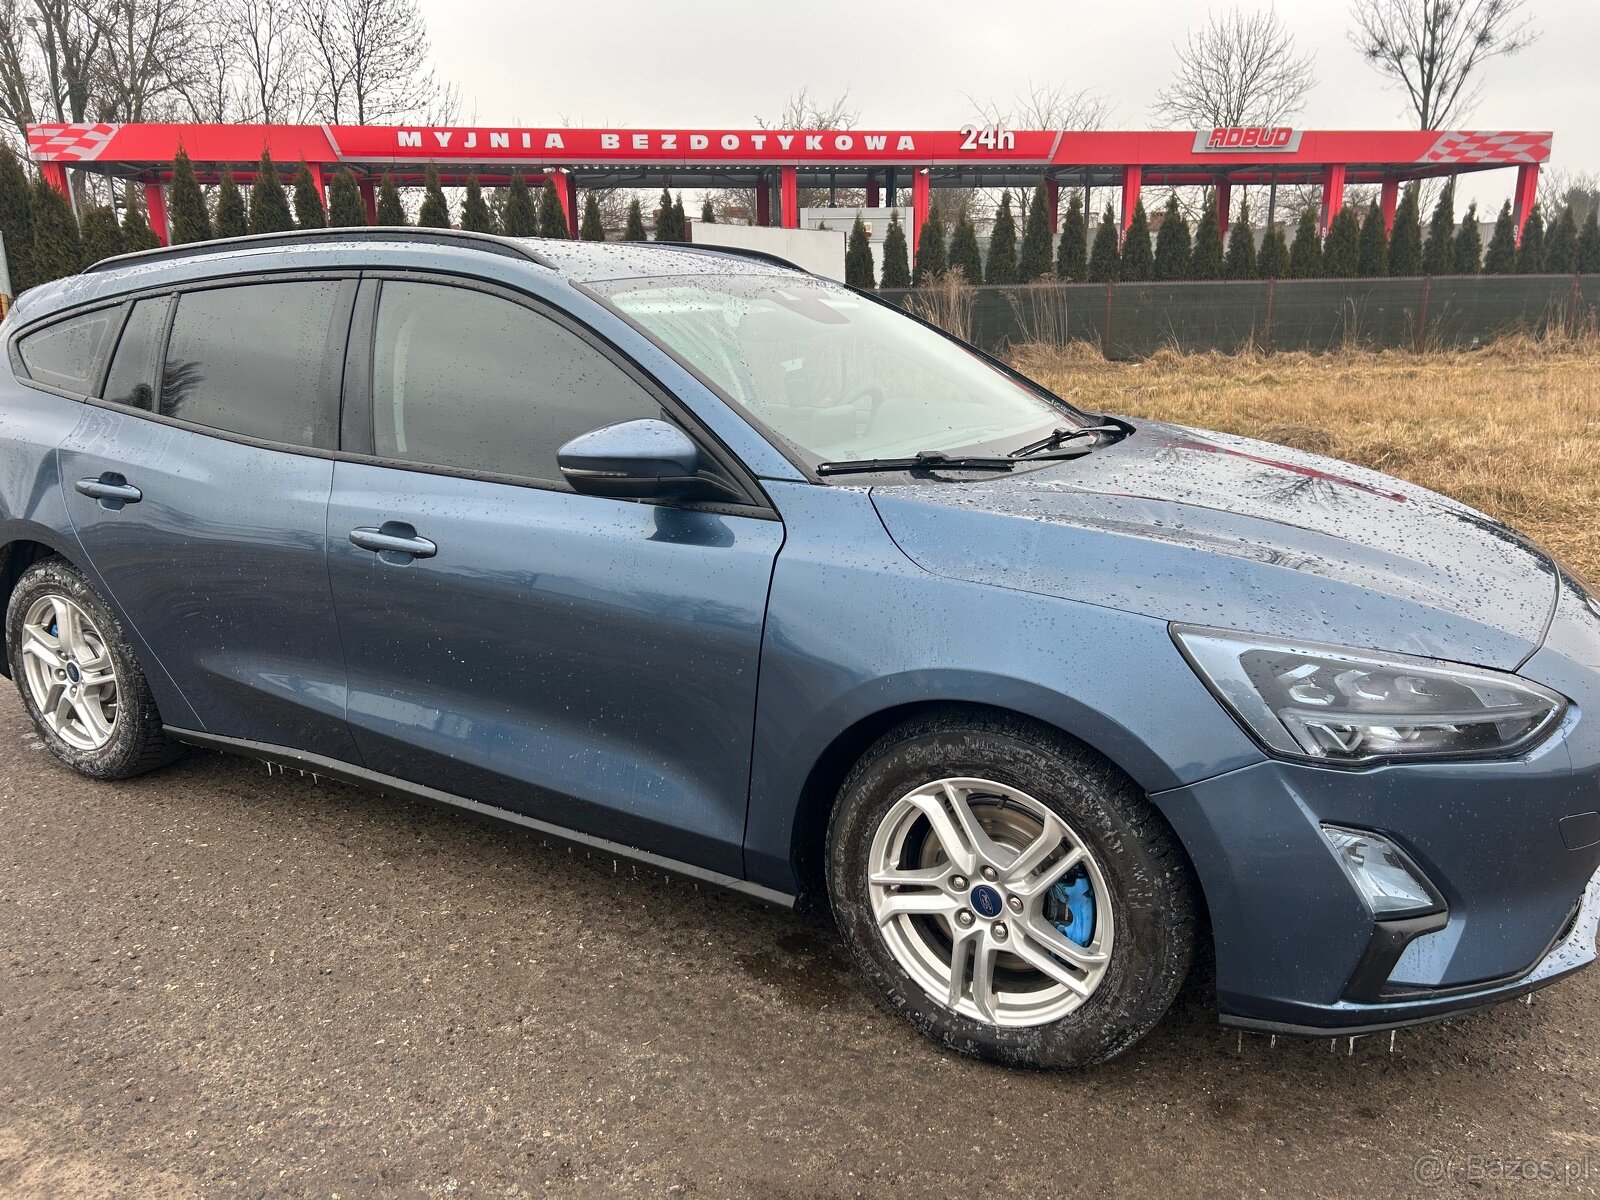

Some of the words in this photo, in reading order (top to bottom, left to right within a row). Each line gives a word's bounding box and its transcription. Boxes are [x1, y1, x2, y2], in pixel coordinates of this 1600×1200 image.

[397, 131, 565, 149] MYJNIA
[601, 133, 916, 151] BEZDOTYKOWA
[959, 122, 1015, 150] 24h
[1207, 127, 1293, 148] ADBUD
